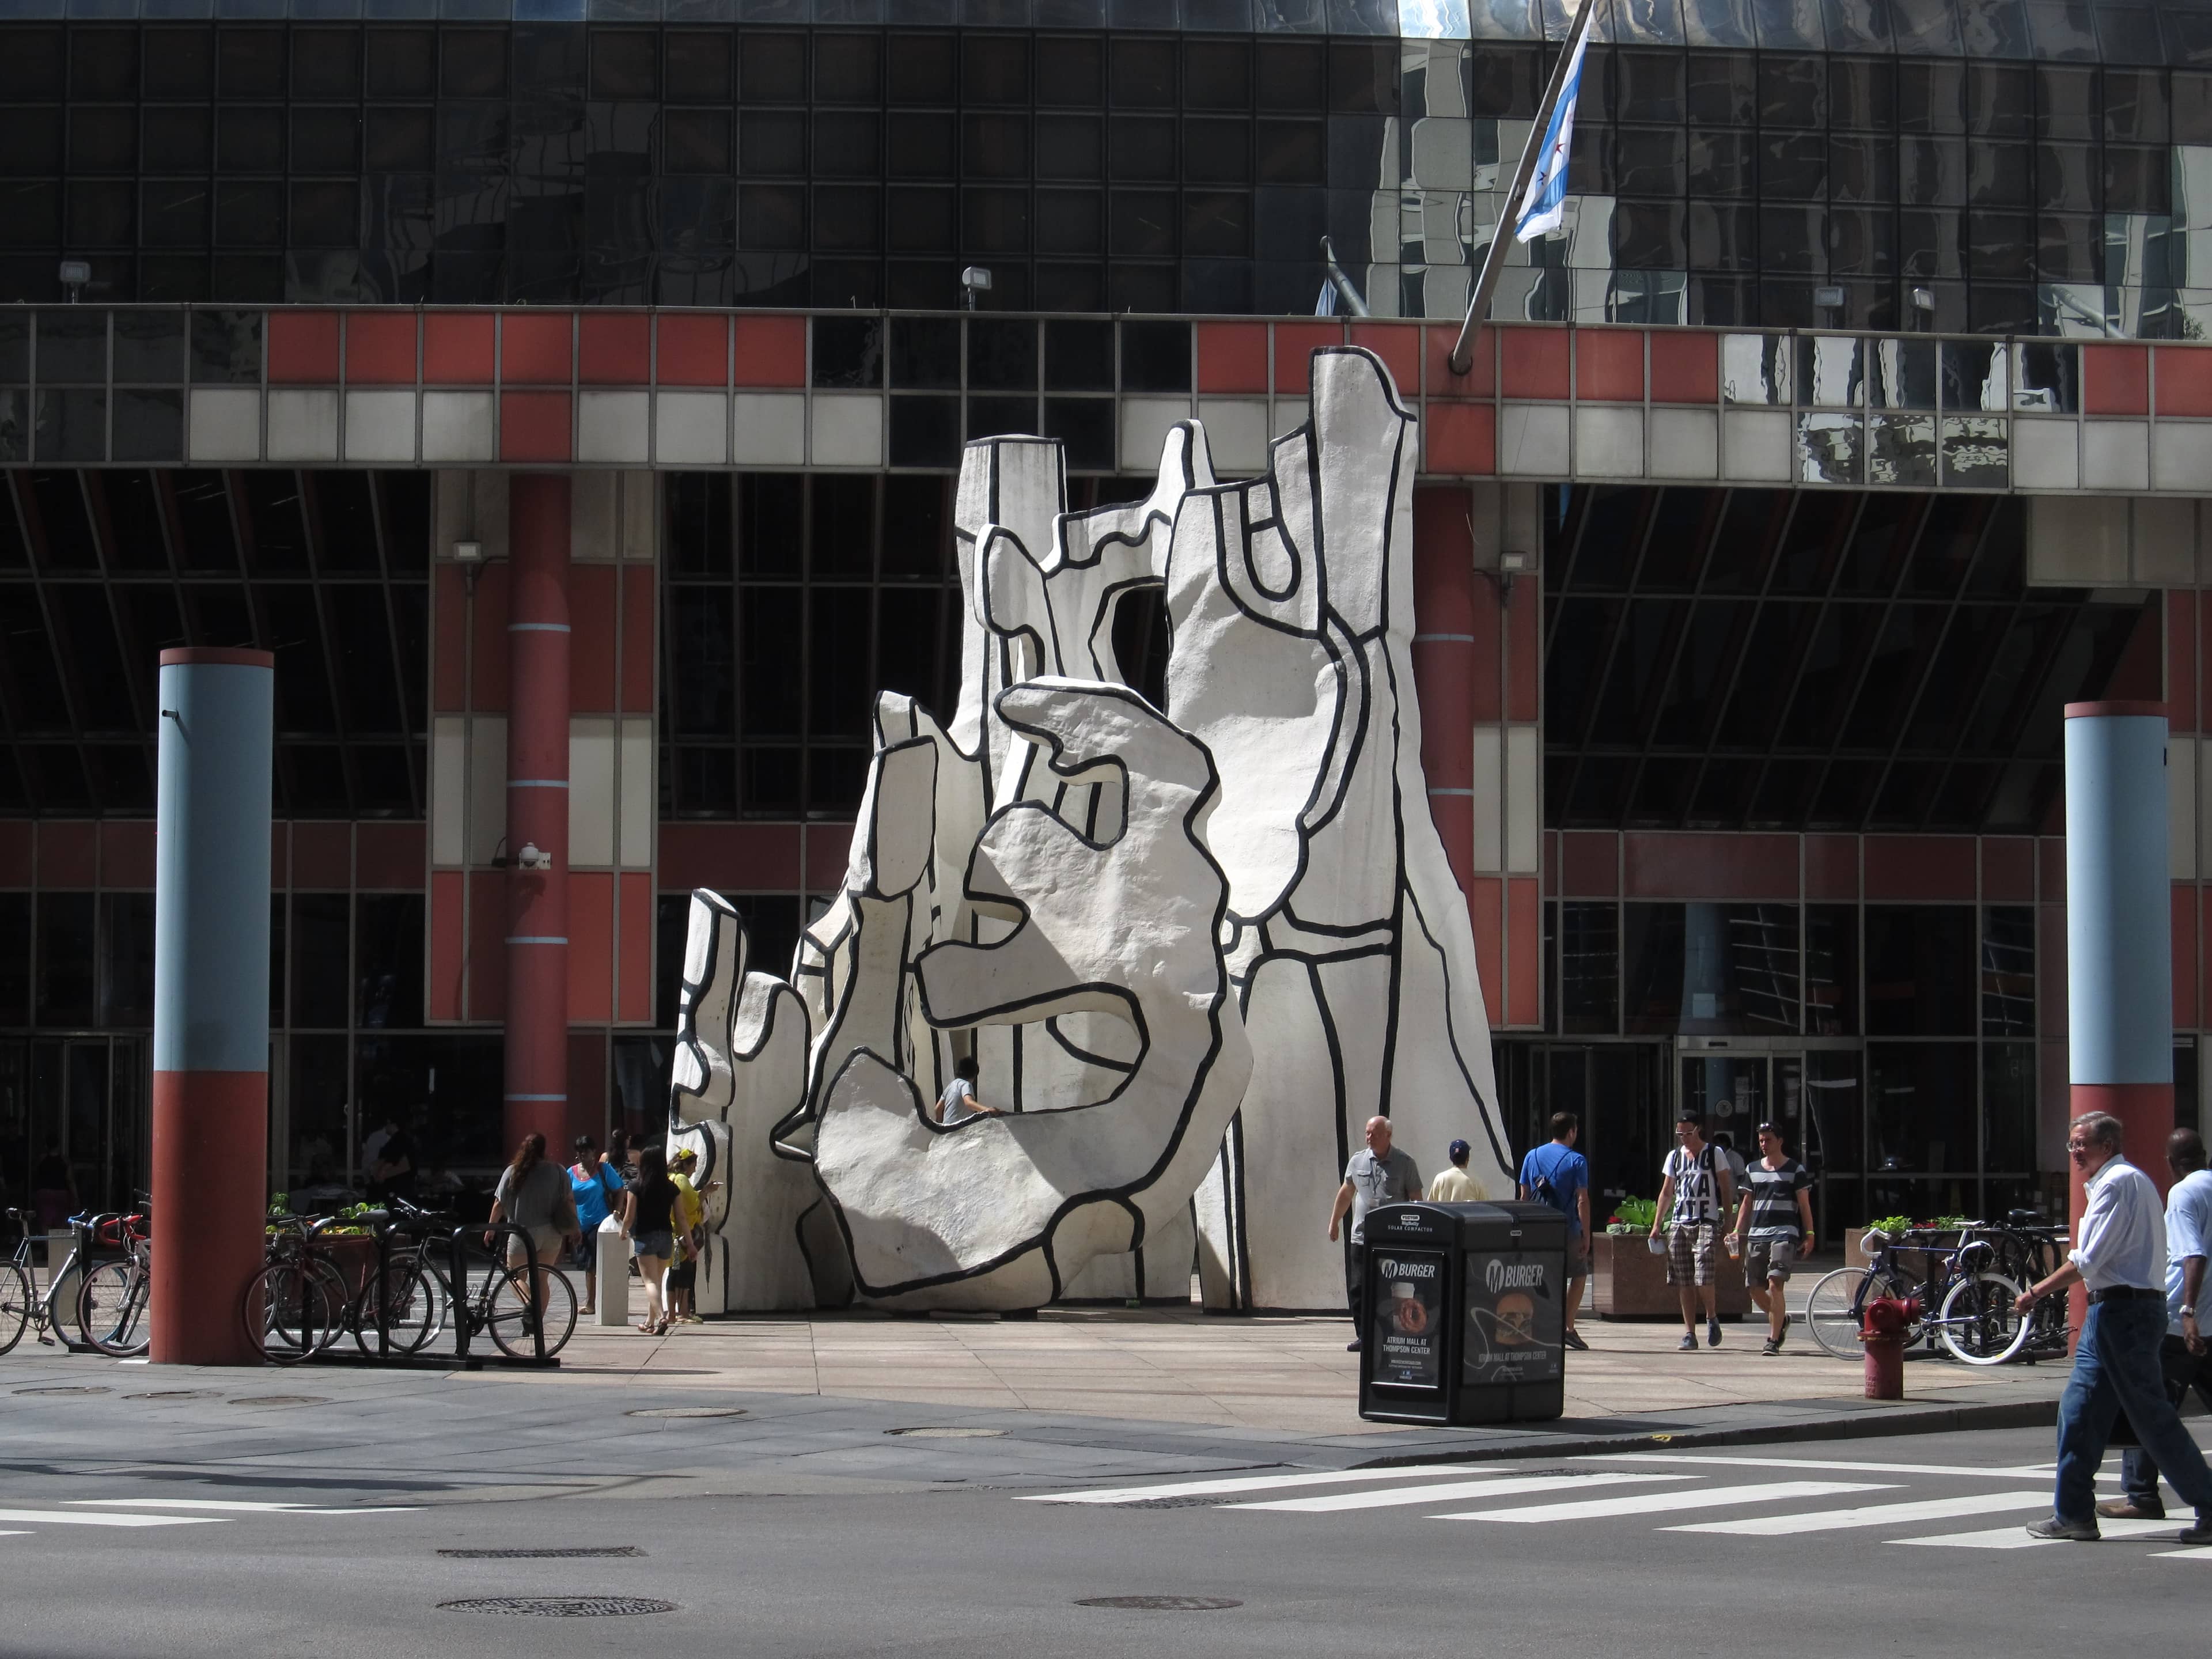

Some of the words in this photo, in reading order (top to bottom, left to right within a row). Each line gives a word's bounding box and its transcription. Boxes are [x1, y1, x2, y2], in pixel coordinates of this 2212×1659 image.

[1399, 1263, 1435, 1278] BURGER
[1505, 1264, 1543, 1287] BURGER
[1387, 1336, 1406, 1344] ATRIUM
[1406, 1338, 1420, 1346] MALL
[1383, 1344, 1410, 1353] THOMPSON
[1411, 1346, 1431, 1355] CENTER
